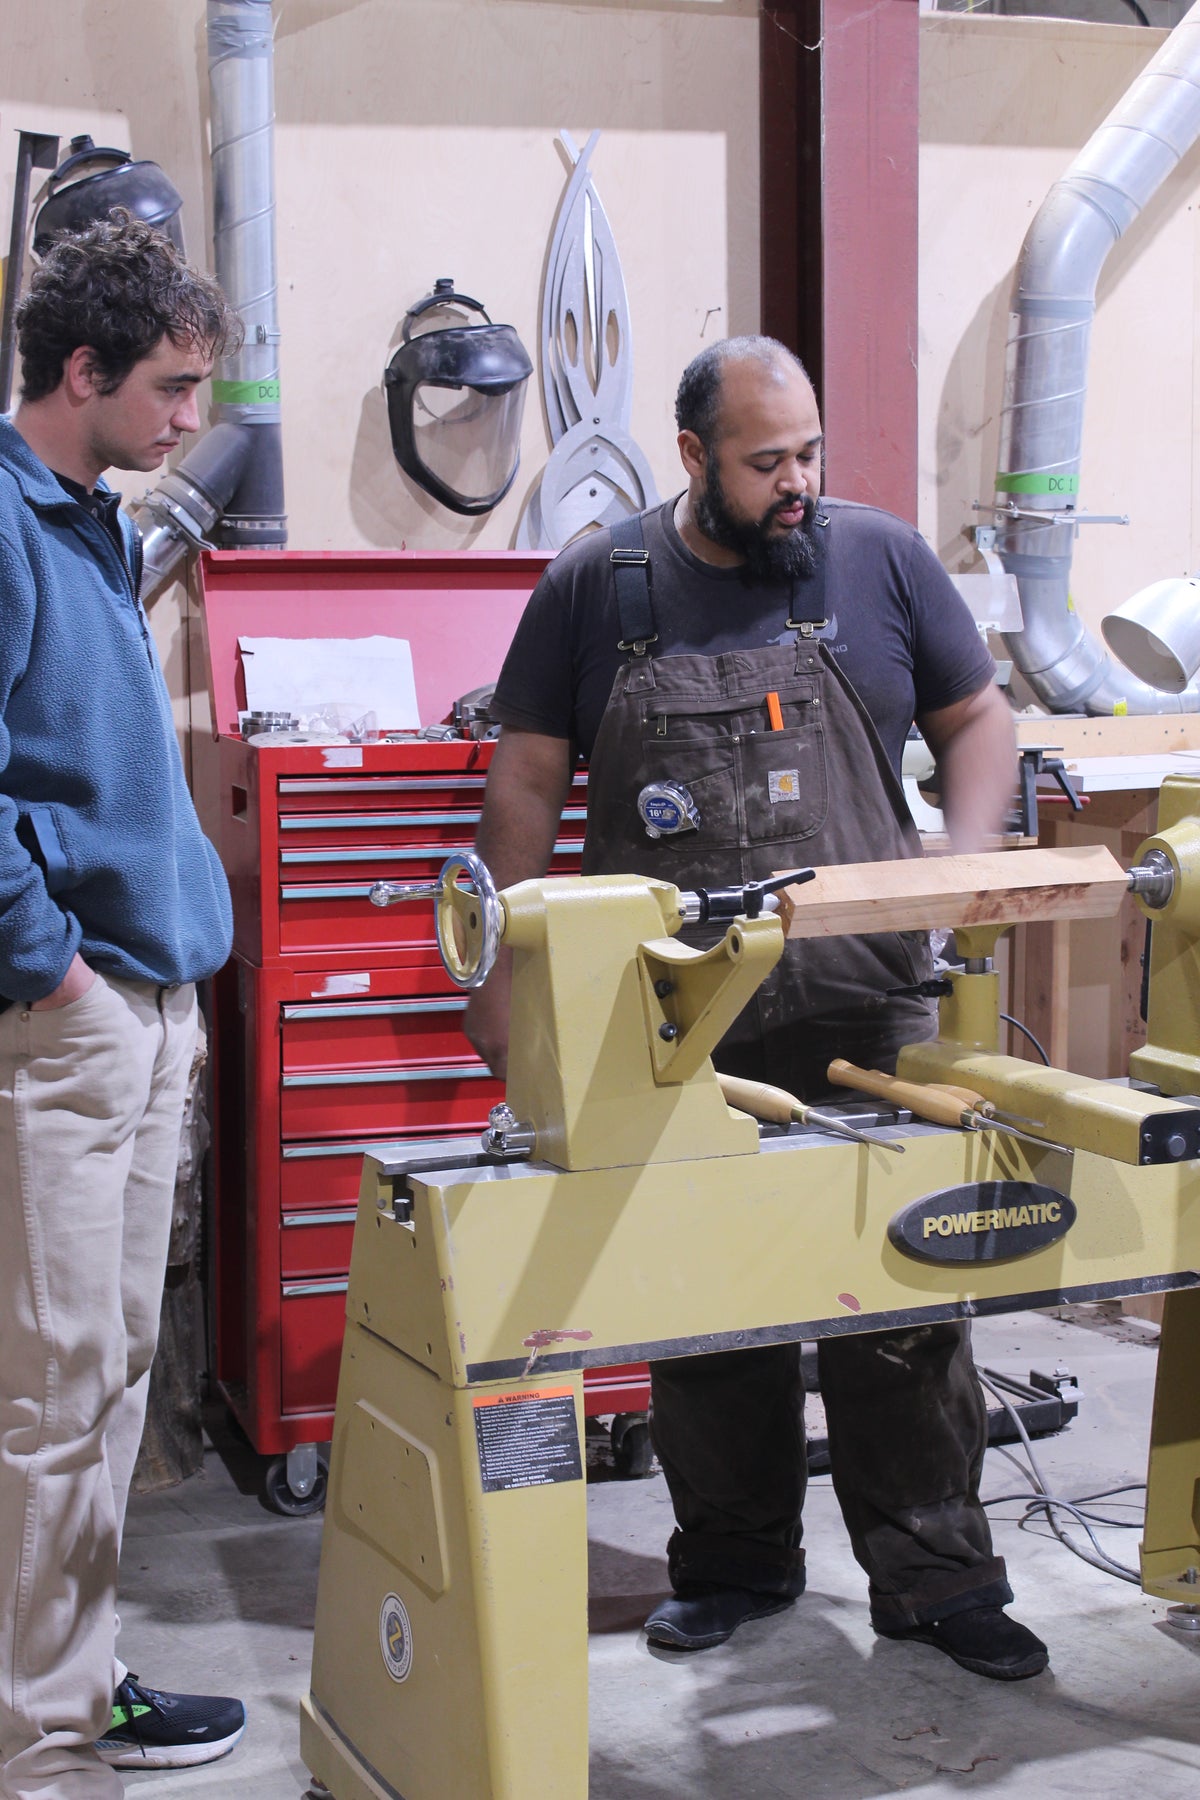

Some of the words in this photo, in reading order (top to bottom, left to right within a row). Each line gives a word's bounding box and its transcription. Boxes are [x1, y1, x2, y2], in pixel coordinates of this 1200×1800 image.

[258, 386, 273, 398] DC
[1048, 477, 1064, 491] DC
[923, 1201, 1061, 1239] POWERMATIC
[505, 1392, 540, 1402] WARNING
